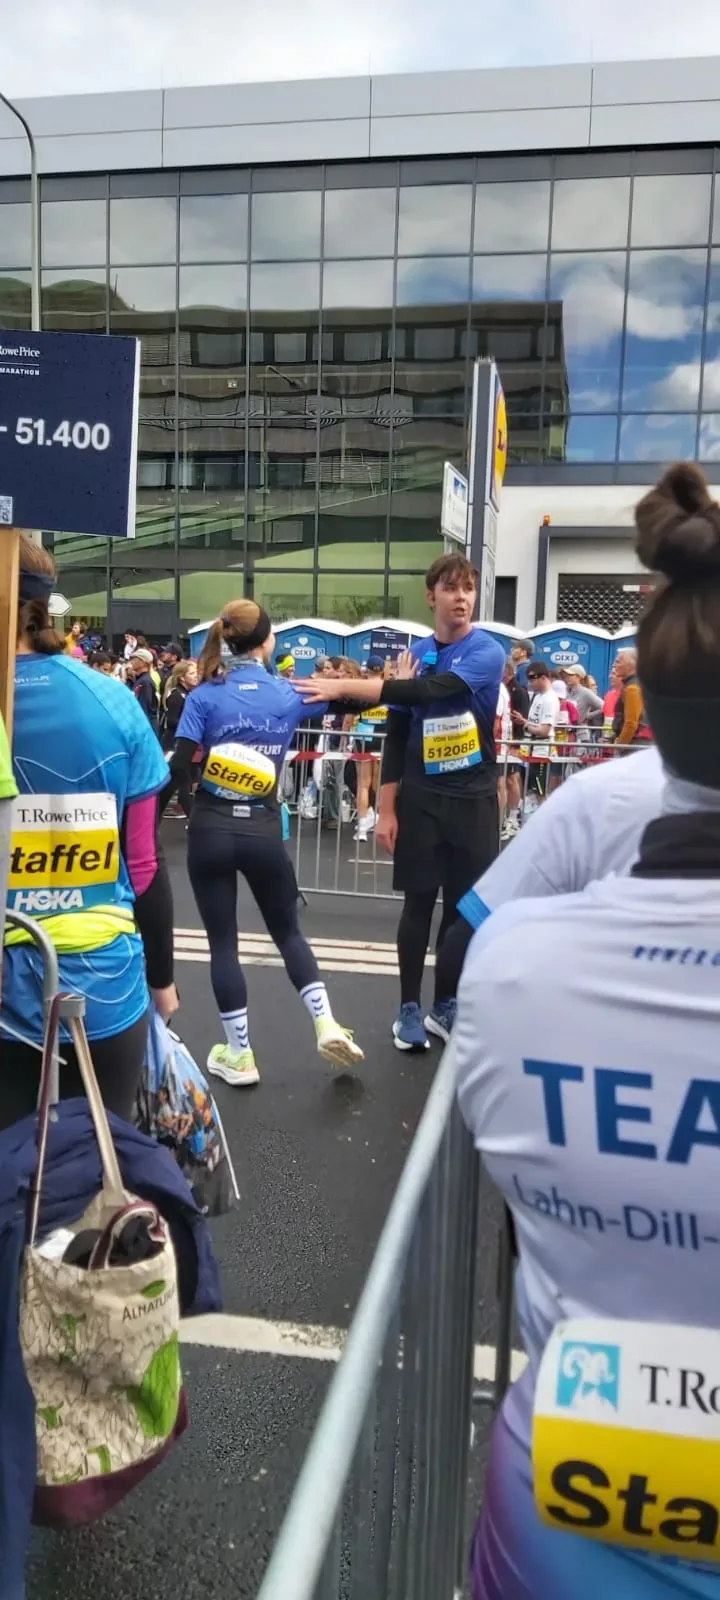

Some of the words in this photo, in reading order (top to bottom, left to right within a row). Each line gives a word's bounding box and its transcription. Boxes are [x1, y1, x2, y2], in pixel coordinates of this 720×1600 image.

[15, 417, 111, 451] 51.400
[428, 739, 475, 759] 51208B
[439, 757, 469, 772] HOKA
[207, 761, 272, 793] Staffel
[13, 888, 85, 913] HOKA
[521, 1057, 720, 1166] TEA
[511, 1173, 720, 1252] Lahn-Dill-
